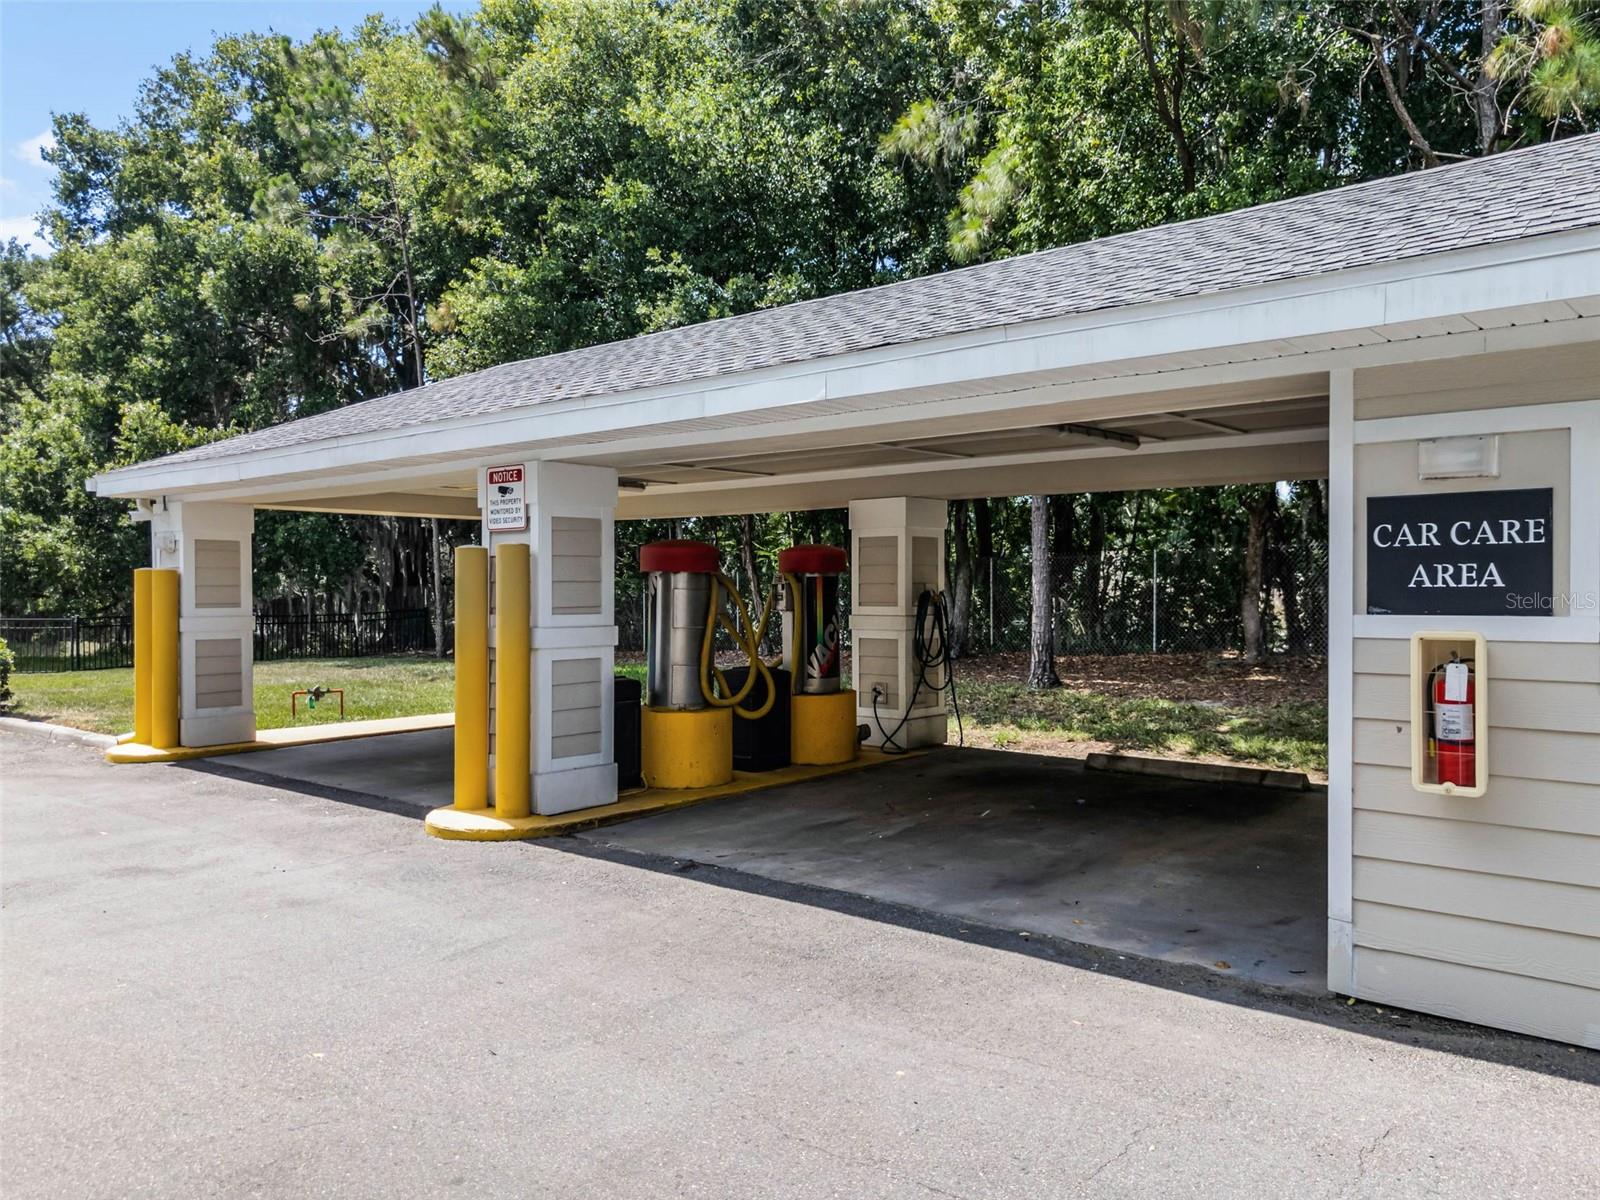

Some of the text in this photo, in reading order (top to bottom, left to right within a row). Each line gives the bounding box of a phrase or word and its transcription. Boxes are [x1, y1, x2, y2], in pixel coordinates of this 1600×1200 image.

[493, 470, 518, 483] NOTICE
[1373, 518, 1546, 547] CAR CARE
[1408, 562, 1506, 588] AREA
